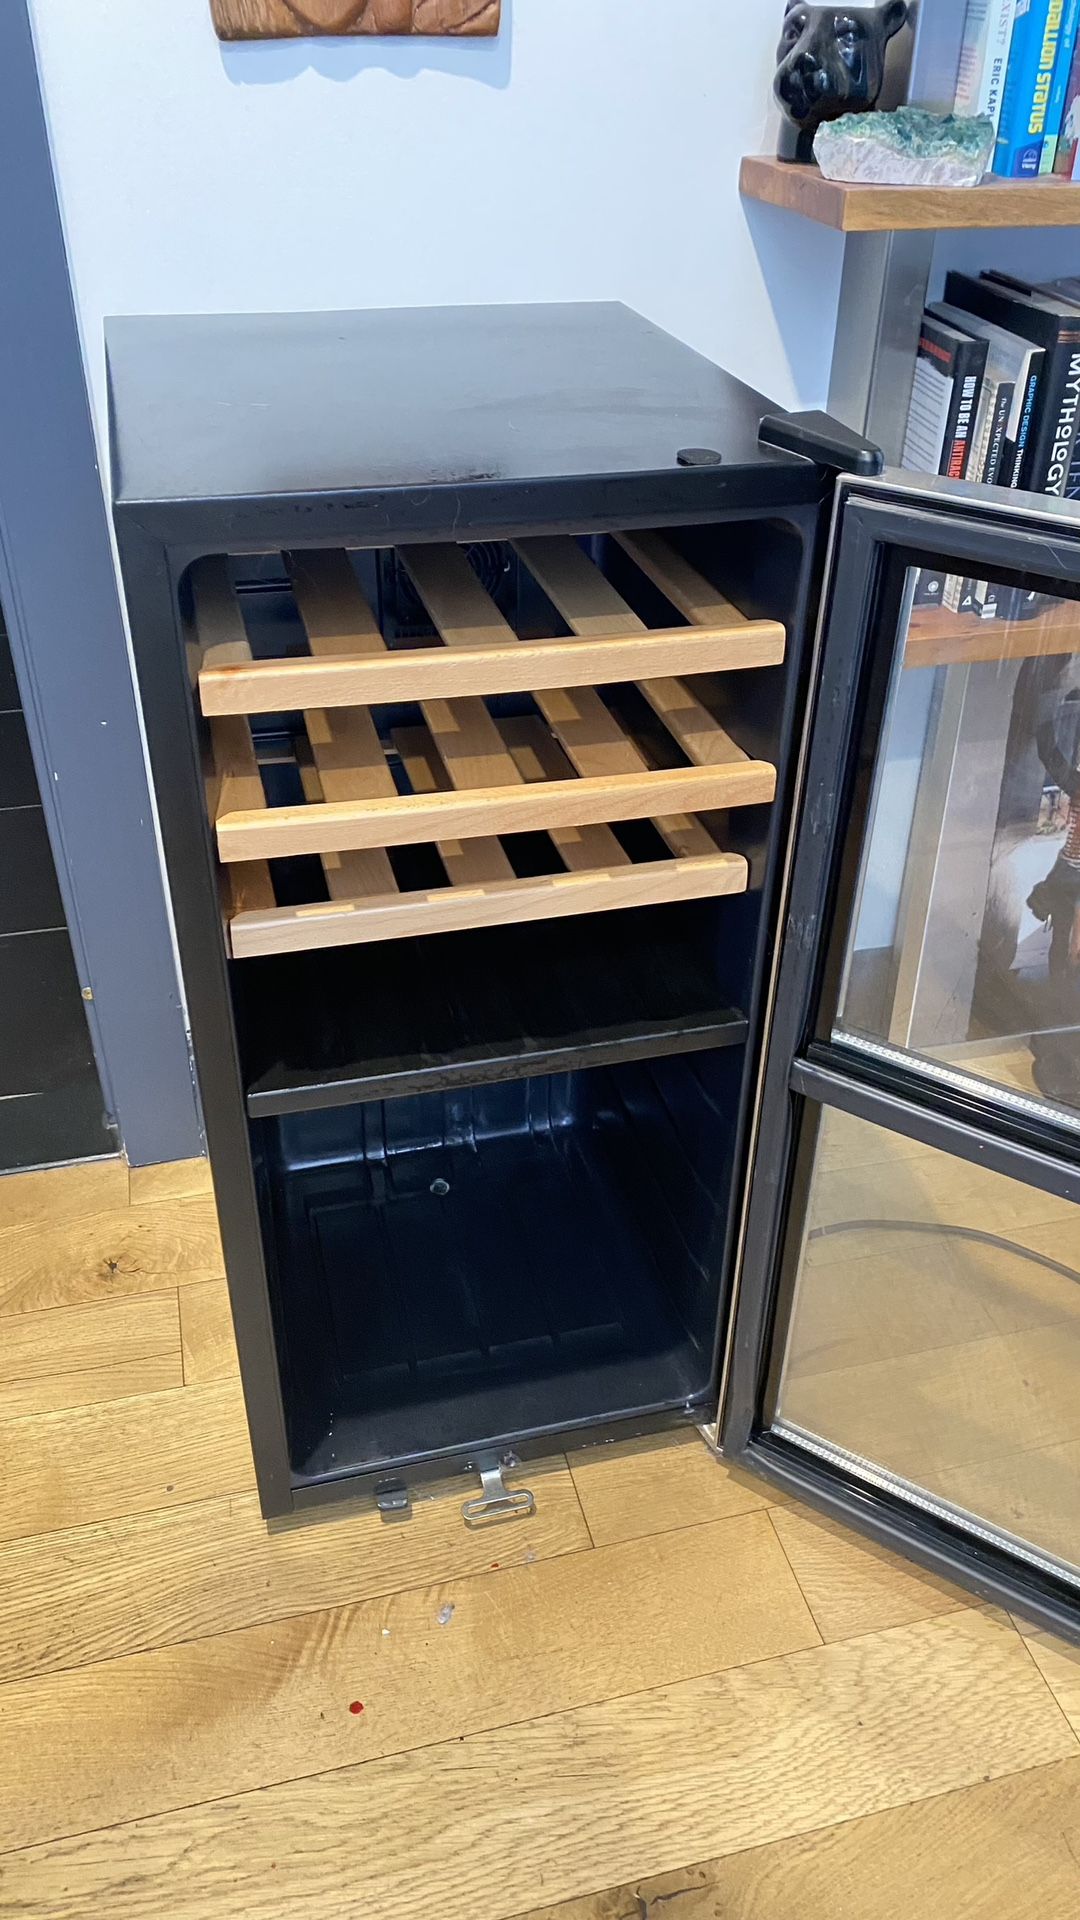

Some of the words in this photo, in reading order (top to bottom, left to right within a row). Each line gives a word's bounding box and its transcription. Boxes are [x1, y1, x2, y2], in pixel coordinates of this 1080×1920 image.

[997, 0, 1012, 45] XIST?
[991, 57, 1003, 85] ERIC
[962, 375, 977, 398] HOW
[1024, 375, 1037, 414] GRAPHIC
[957, 412, 969, 424] BE
[959, 399, 973, 411] TO
[954, 425, 967, 438] AN
[1018, 415, 1029, 448] DESIGN
[1044, 353, 1080, 496] MYTHOLOGY
[1010, 448, 1024, 489] THINKING
